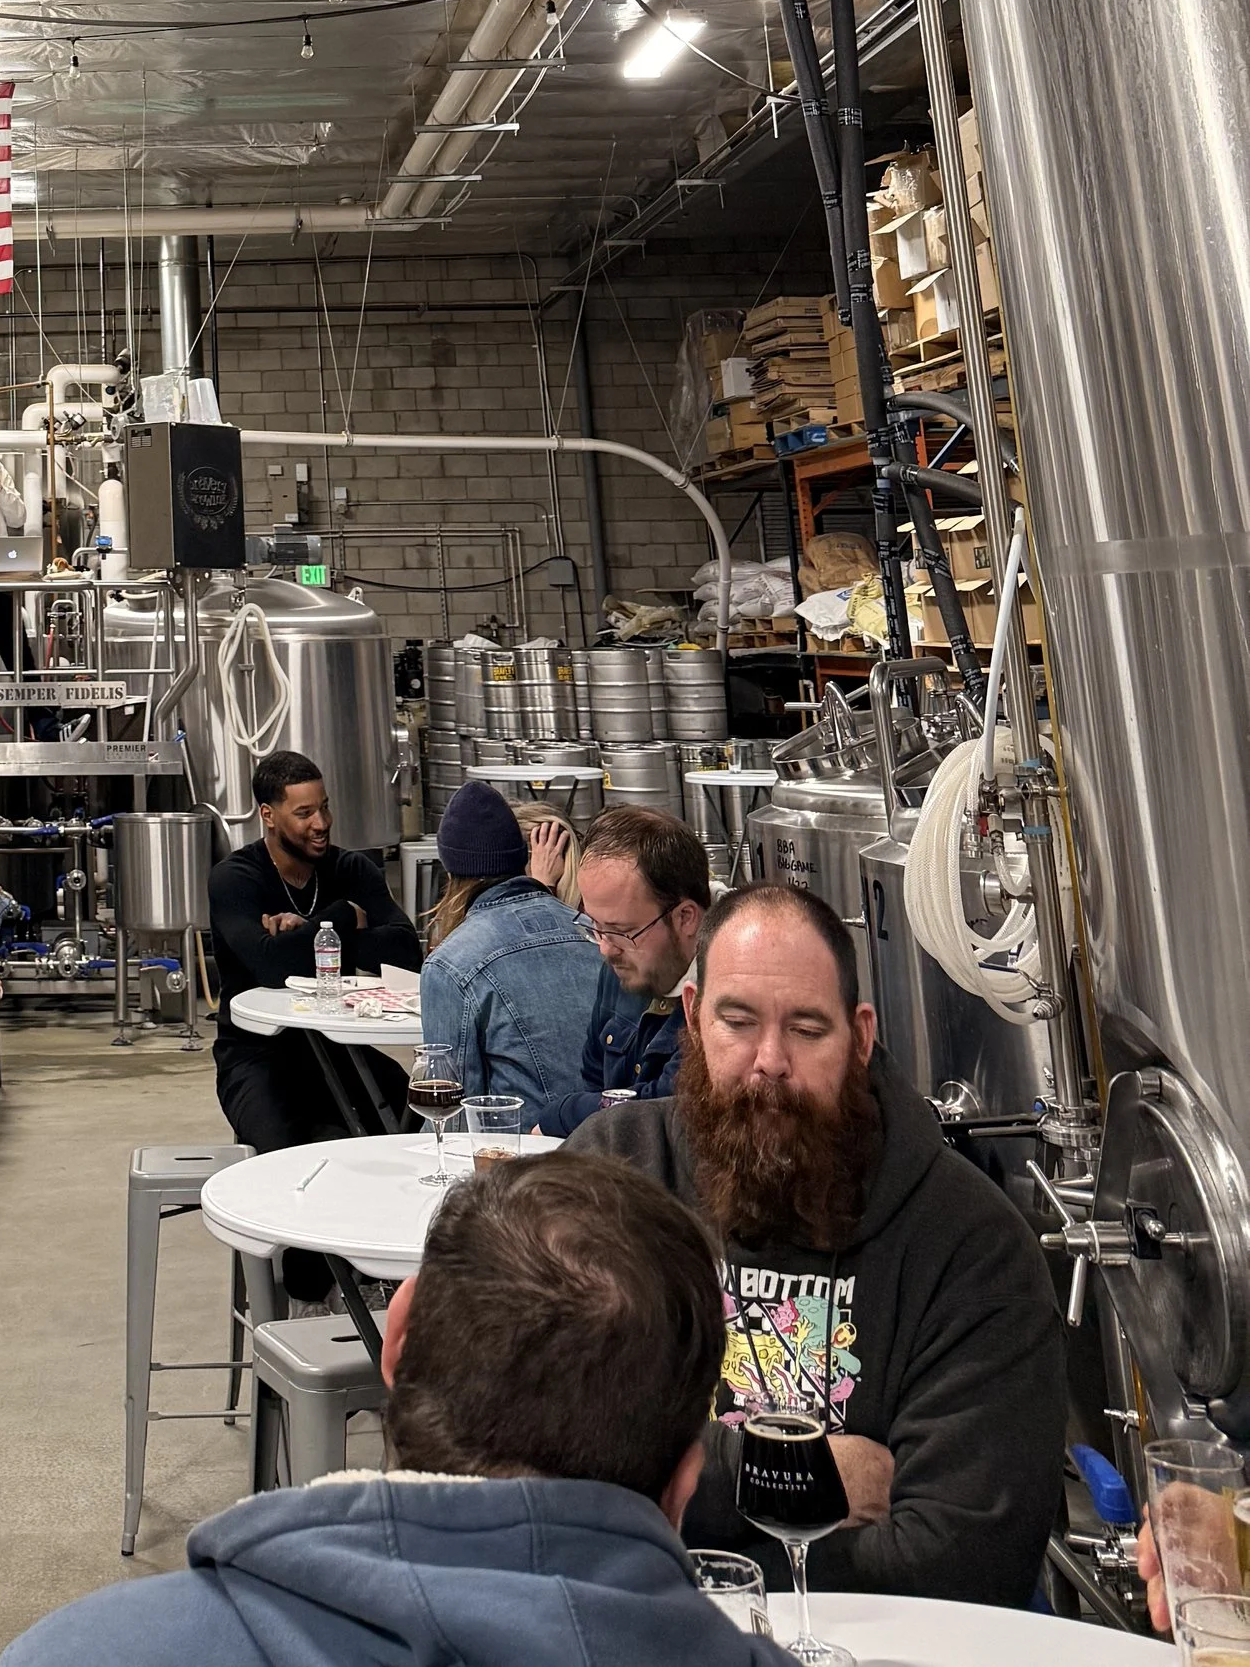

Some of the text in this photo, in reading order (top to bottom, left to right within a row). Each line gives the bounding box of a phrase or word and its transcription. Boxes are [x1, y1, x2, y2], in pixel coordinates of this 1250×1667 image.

[302, 565, 326, 585] EXIT
[65, 687, 123, 700] FIDELIS
[106, 744, 146, 752] PREMIER
[776, 838, 796, 855] BBA
[790, 859, 818, 874] GAME
[872, 879, 889, 941] 2
[739, 1266, 856, 1305] BOTTOM
[745, 1462, 815, 1482] BRAVURA
[749, 1477, 808, 1492] COLLECTIVE
